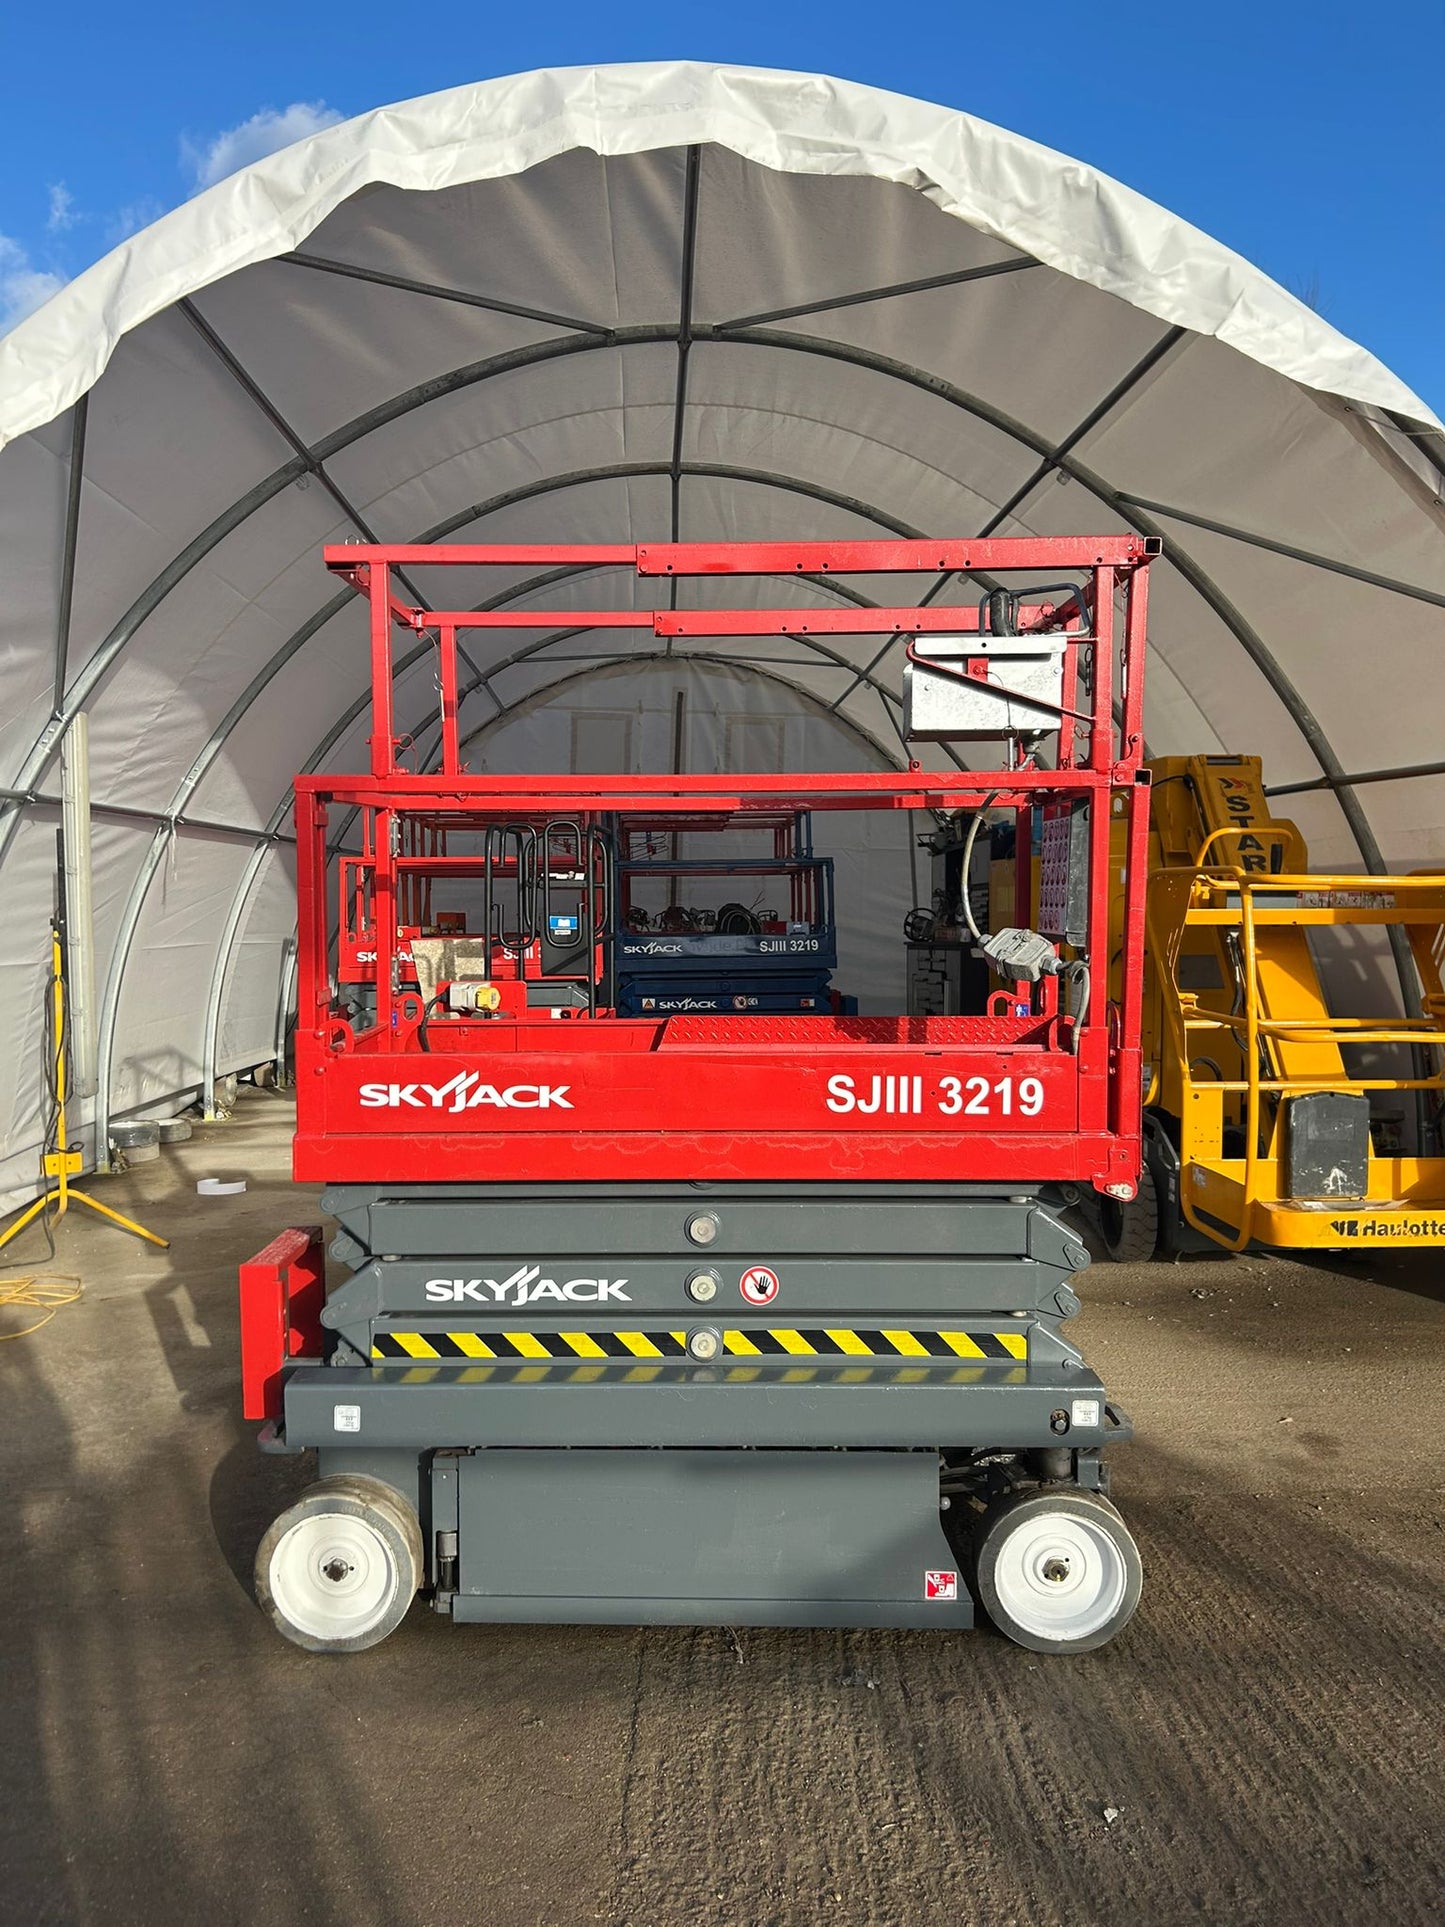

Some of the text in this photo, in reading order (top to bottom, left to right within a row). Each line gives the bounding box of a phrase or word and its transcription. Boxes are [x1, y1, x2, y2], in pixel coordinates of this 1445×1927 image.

[1226, 795, 1267, 872] STAR
[624, 941, 683, 954] SKYJACK
[759, 940, 787, 953] SJIII
[790, 939, 819, 952] 3219
[658, 997, 718, 1011] SKYJACK
[358, 1070, 576, 1113] SKYJACK
[825, 1074, 1045, 1117] SJIII 3219
[424, 1264, 633, 1307] SKYJACK
